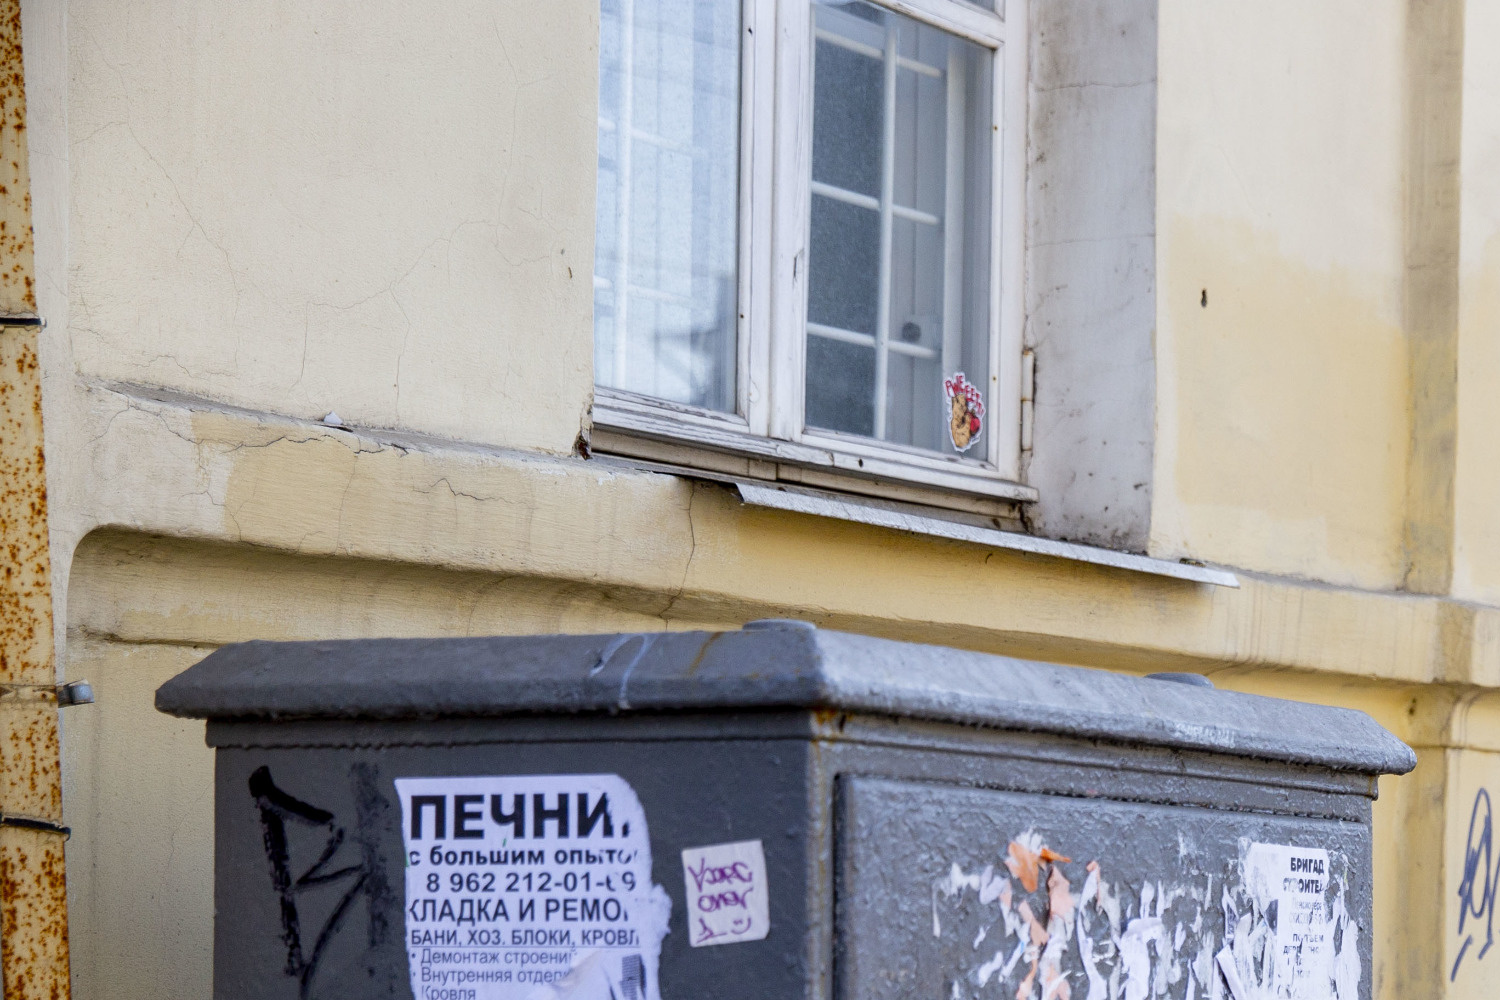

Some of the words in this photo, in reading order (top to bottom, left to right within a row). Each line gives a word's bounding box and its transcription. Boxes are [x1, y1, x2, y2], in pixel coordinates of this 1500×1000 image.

[410, 791, 630, 840] ПЕЧНИ
[430, 845, 545, 867] большим
[554, 849, 637, 866] опыто
[426, 873, 440, 892] 8
[450, 873, 495, 892] 962
[519, 899, 535, 922] И
[545, 898, 628, 922] РЕМО
[411, 930, 462, 947] БАНИ,
[467, 930, 506, 946] ХОЗ.
[511, 928, 576, 949] БЛОКИ,
[421, 951, 499, 967] Демонтаж
[504, 951, 573, 966] строени
[421, 968, 512, 987] Внутренняя
